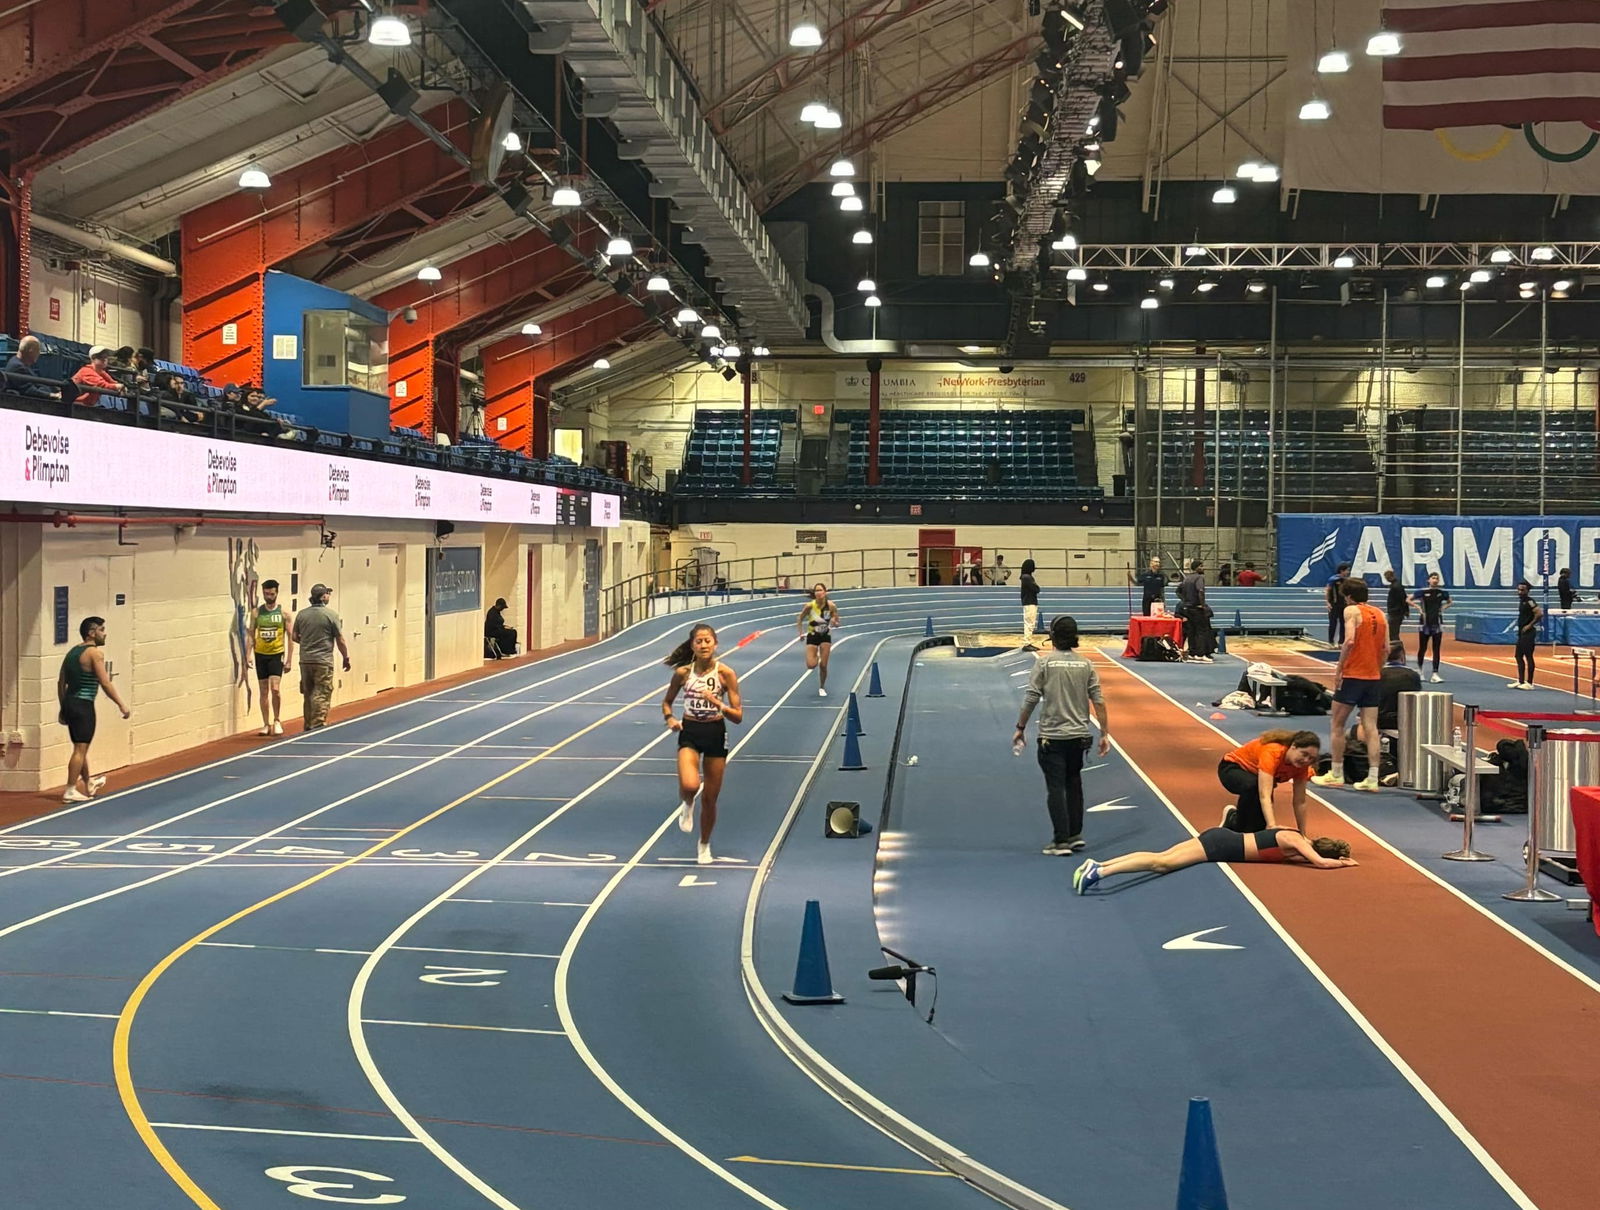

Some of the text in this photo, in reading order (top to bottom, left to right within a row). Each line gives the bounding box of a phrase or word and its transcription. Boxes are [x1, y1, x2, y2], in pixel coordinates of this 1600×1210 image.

[862, 378, 916, 387] CUMBIA
[944, 377, 1046, 389] NewYork-Presbyterian
[25, 425, 70, 455] Debevoise
[208, 449, 237, 472] Debevoise
[24, 455, 70, 488] & Plimpton
[212, 472, 237, 500] Plimpton
[706, 677, 716, 691] 9
[126, 842, 215, 852] 5
[256, 845, 345, 855] 4
[391, 848, 480, 858] 3
[524, 852, 617, 862] 2
[418, 964, 508, 987] 2
[264, 1165, 407, 1205] 3
